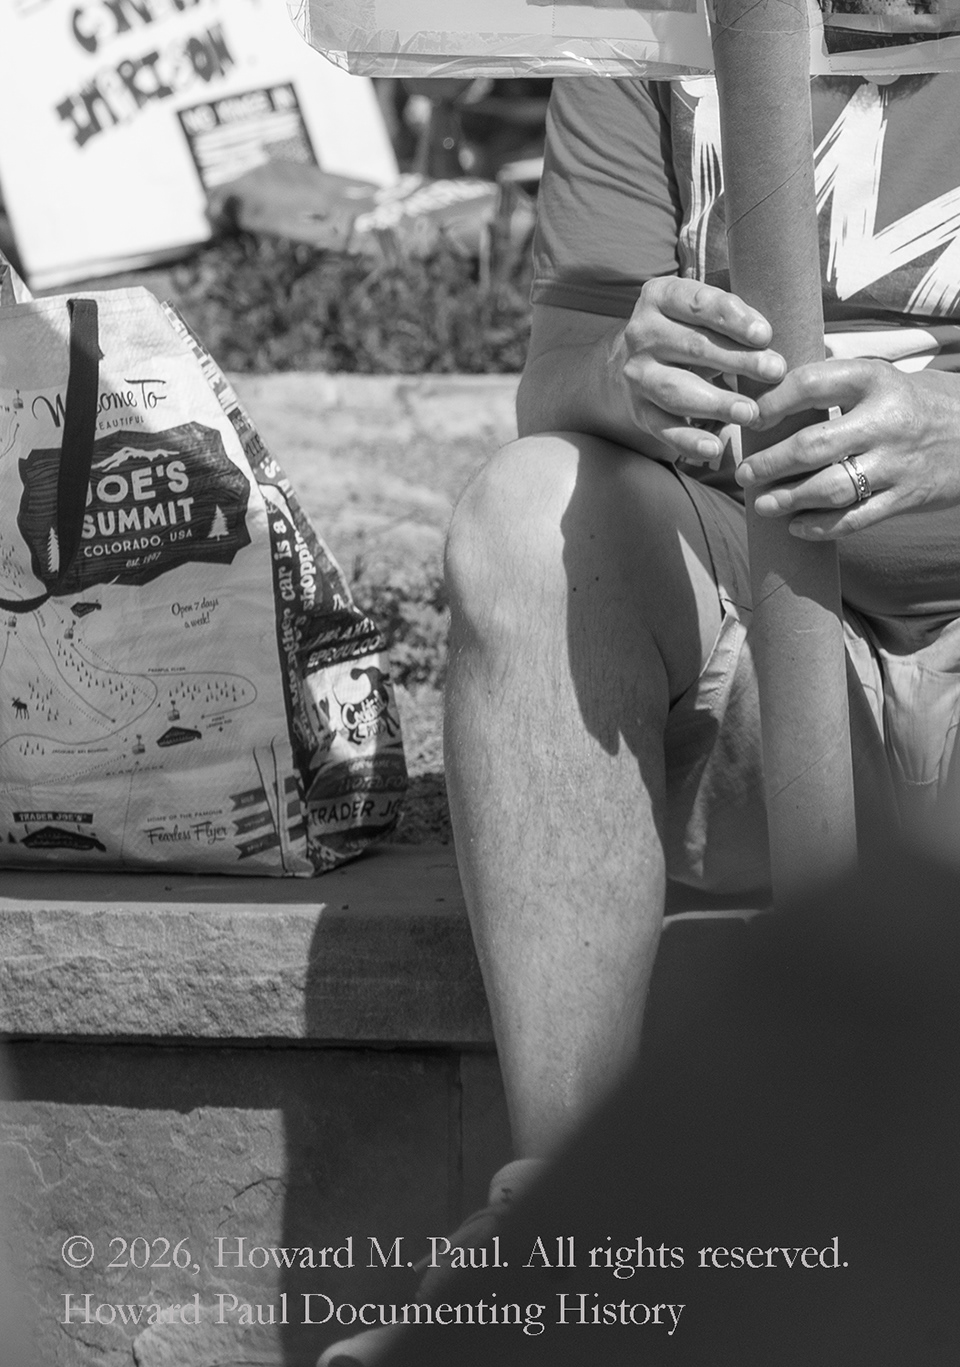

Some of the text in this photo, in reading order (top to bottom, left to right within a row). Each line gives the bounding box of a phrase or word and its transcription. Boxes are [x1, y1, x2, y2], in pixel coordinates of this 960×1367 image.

[31, 378, 167, 428] Wome To
[95, 415, 145, 431] EAUTIFUL
[81, 497, 194, 539] SUMMIT
[272, 519, 287, 534] a
[84, 528, 193, 558] COLORADO, USA
[273, 539, 293, 561] is
[278, 566, 296, 602] car
[171, 601, 193, 618] Open
[200, 596, 219, 612] days
[310, 800, 376, 826] TRADER
[142, 824, 191, 845] Fearless
[189, 820, 227, 845] Flyer
